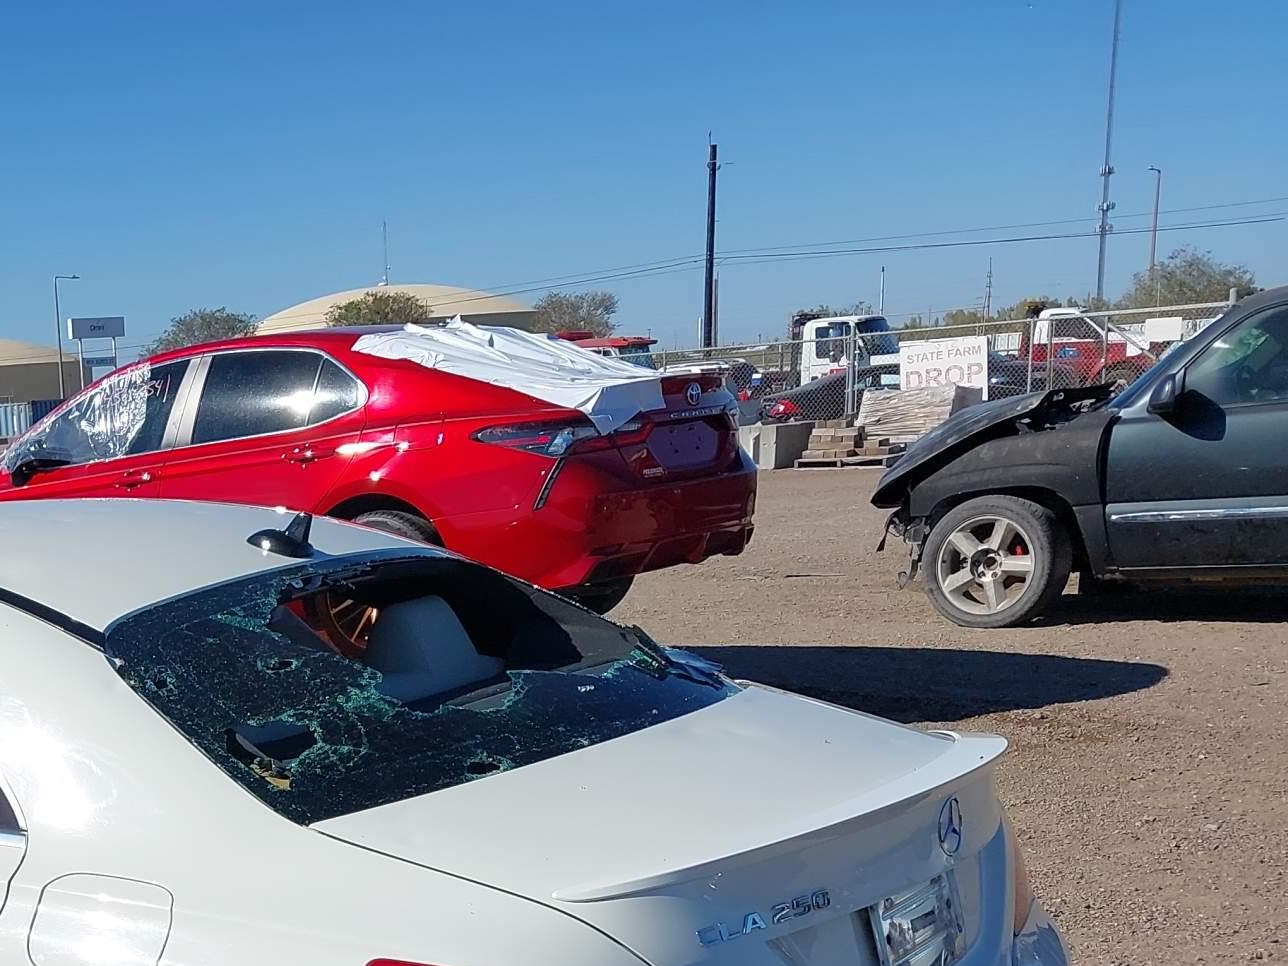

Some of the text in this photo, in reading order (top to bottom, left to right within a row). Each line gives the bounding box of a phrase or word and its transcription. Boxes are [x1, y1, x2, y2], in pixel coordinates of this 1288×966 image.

[906, 344, 982, 364] STATE FARM
[905, 363, 984, 390] DROP
[695, 889, 831, 945] CLA 250
